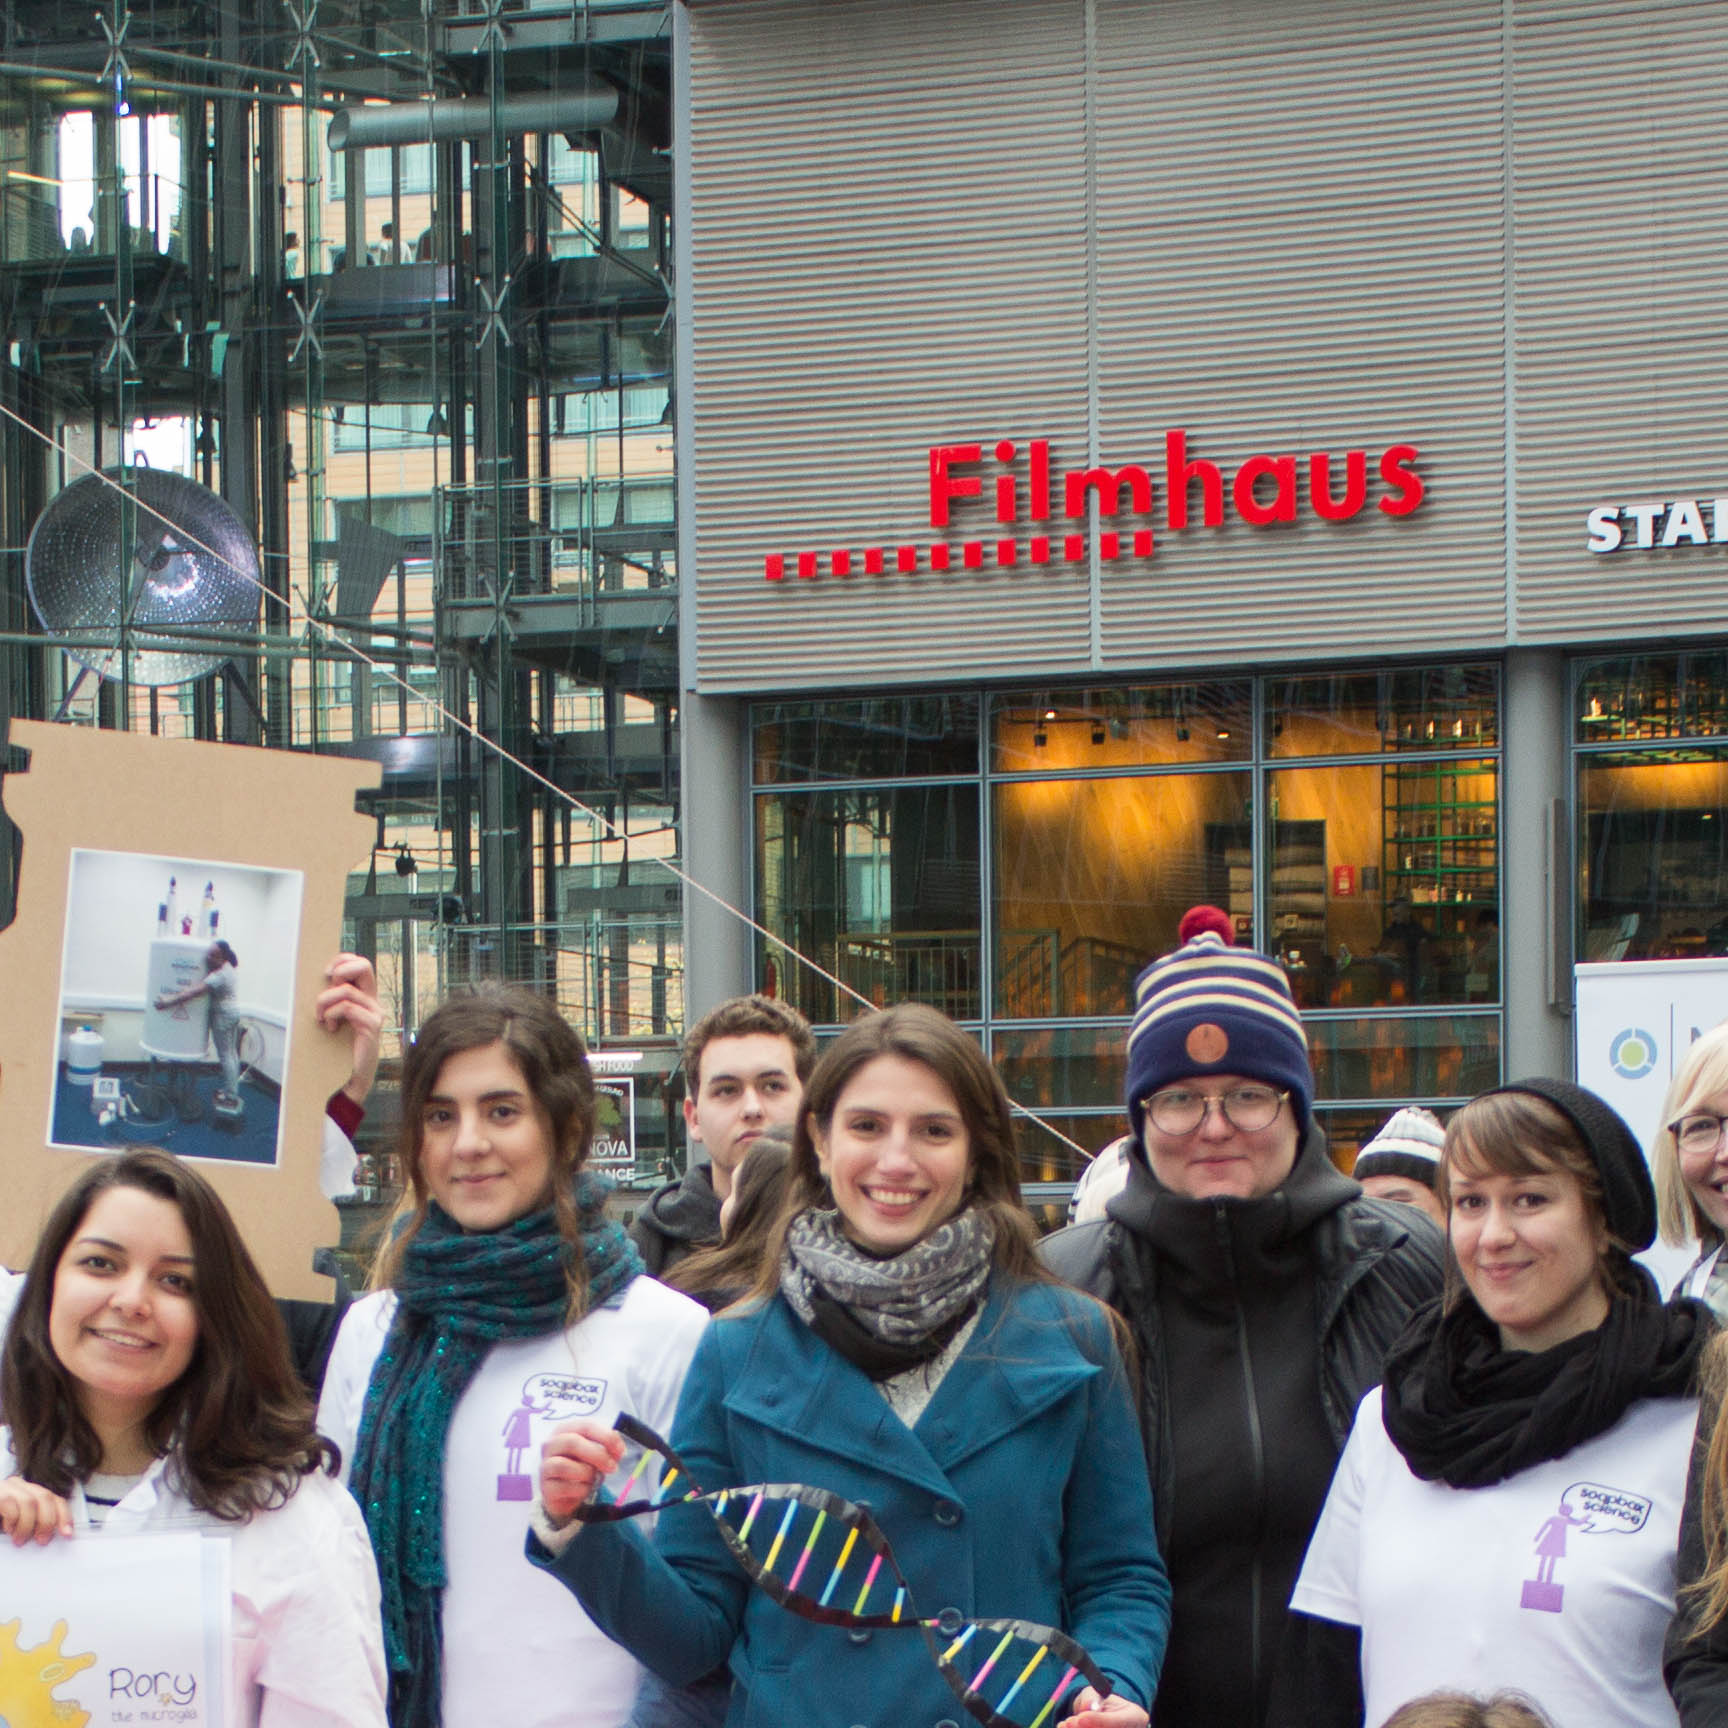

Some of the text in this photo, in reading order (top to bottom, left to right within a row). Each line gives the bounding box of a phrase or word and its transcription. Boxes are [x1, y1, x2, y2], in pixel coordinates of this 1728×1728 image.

[929, 430, 1425, 530] Filmhaus
[540, 1379, 599, 1394] soapbox
[543, 1389, 597, 1406] science
[1580, 1488, 1645, 1513] soapbox
[1584, 1501, 1640, 1525] science
[109, 1667, 197, 1706] Rory
